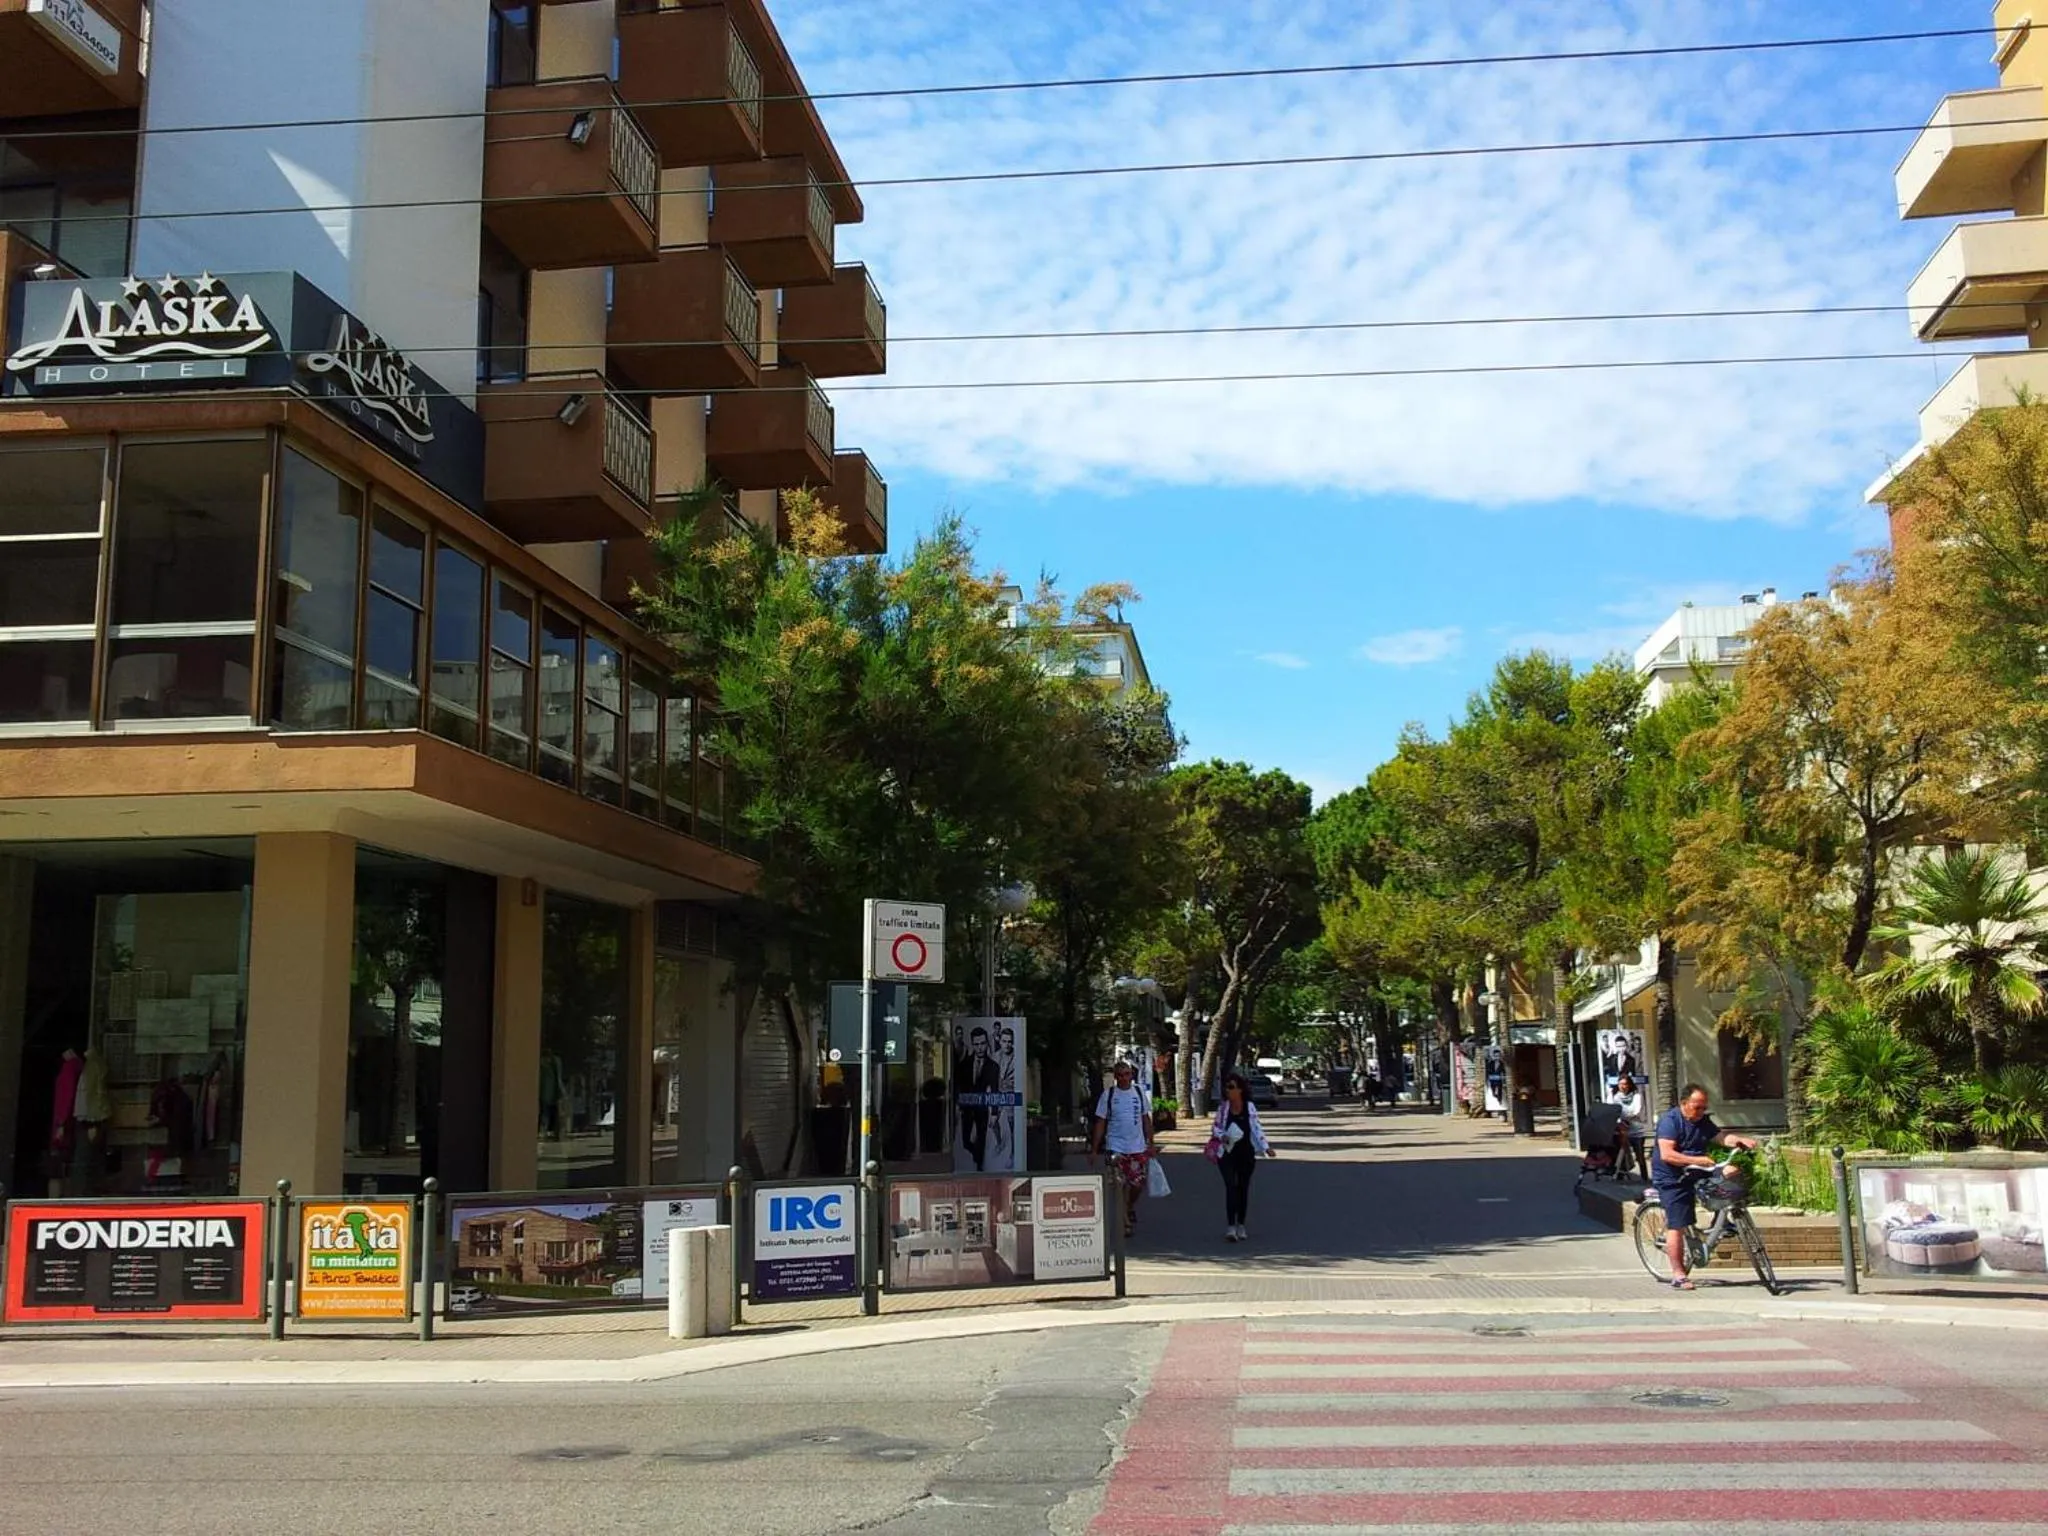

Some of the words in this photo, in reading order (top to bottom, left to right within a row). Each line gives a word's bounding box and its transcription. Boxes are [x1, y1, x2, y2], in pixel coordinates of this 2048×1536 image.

[9, 287, 271, 368] ALASKA
[44, 361, 236, 383] HOTEL
[307, 313, 434, 440] ALASKA
[328, 383, 421, 457] HOTEL
[901, 909, 918, 917] zona
[879, 918, 908, 929] traffico
[910, 919, 940, 930] limitato
[770, 1194, 842, 1232] IRC
[36, 1220, 235, 1250] FONDERIA
[759, 1239, 787, 1247] Istituto
[789, 1237, 825, 1247] Recupero
[826, 1235, 852, 1244] Crediti
[1047, 1238, 1093, 1249] PESARO
[312, 1255, 326, 1267] in
[328, 1255, 397, 1267] miniatura
[322, 1272, 351, 1284] Parco
[354, 1272, 400, 1284] Tematico
